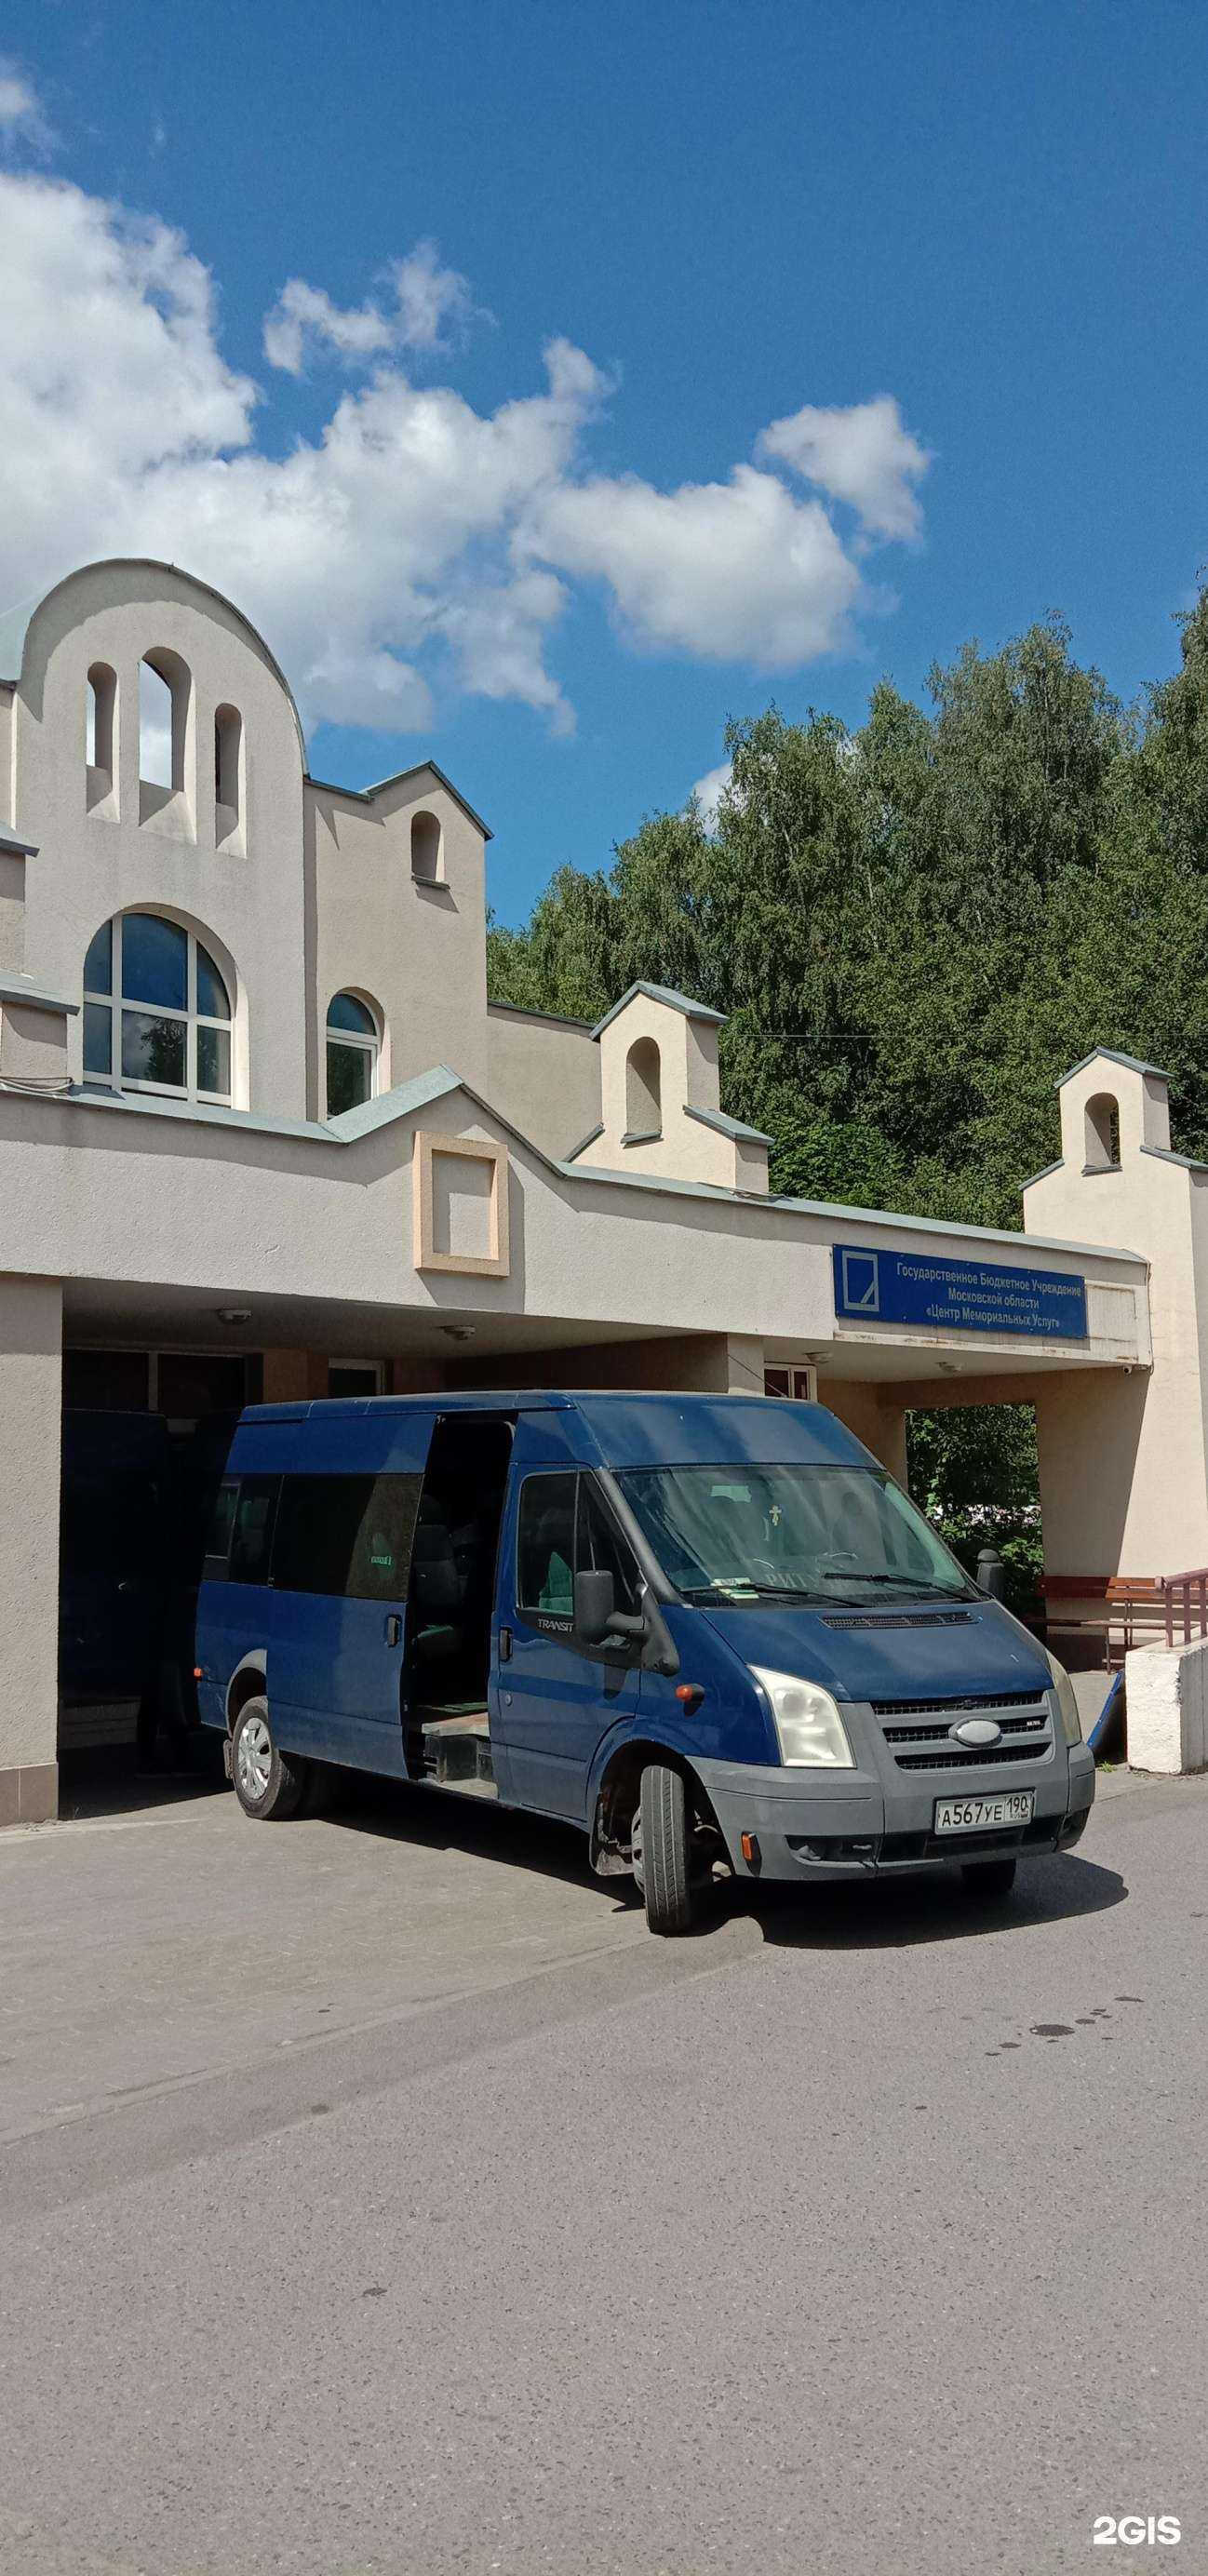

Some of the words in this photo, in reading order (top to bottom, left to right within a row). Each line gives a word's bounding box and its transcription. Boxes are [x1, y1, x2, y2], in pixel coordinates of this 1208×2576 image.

[896, 1262, 978, 1283] Государственное
[979, 1273, 1030, 1292] Бюджетное
[1030, 1279, 1081, 1296] Учреждение
[947, 1287, 1003, 1306] Московской
[1004, 1294, 1040, 1309] области
[926, 1304, 960, 1322] «Центр
[961, 1307, 1031, 1326] Мемориальных
[1031, 1313, 1060, 1331] Услуг»
[538, 1618, 574, 1633] TRANSIT
[1006, 1795, 1027, 1814] 190
